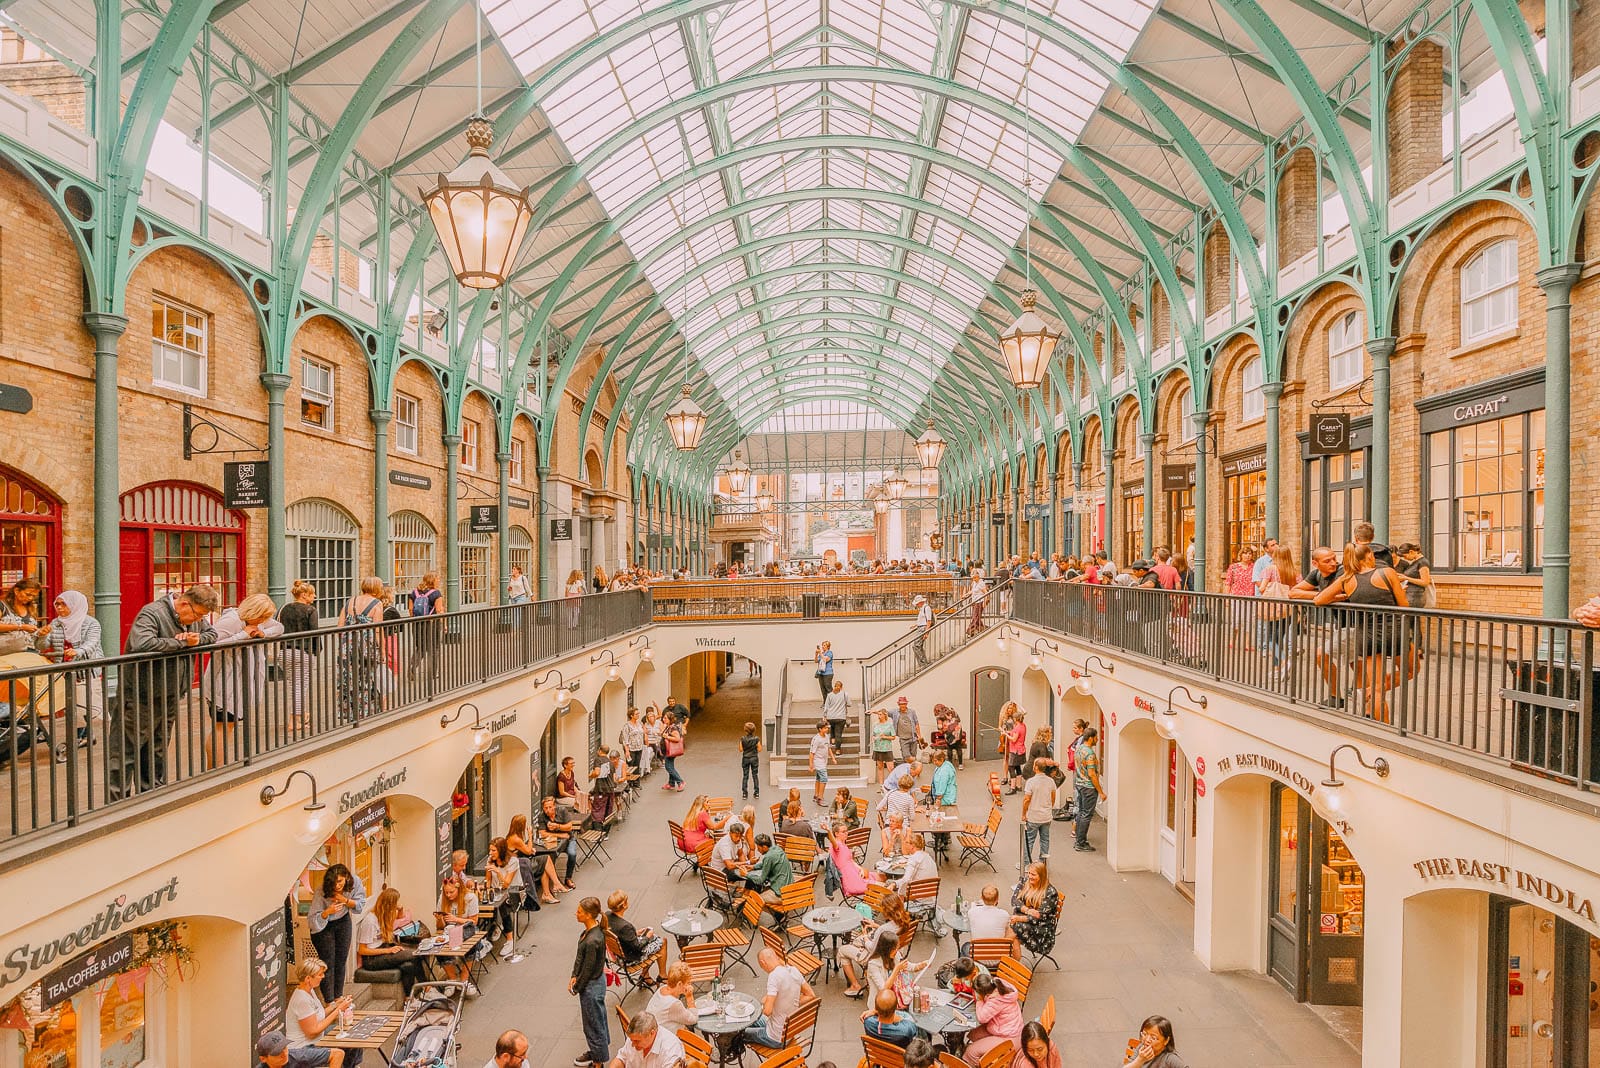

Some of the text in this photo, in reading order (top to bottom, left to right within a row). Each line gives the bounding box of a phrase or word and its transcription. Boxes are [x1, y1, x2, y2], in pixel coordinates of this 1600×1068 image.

[1453, 398, 1502, 421] CARAT
[1236, 456, 1263, 472] Venchi
[695, 637, 736, 647] Whittard
[491, 709, 517, 733] Italiani
[1235, 753, 1260, 767] EAST
[1260, 755, 1292, 780] INDIA
[339, 766, 407, 814] Sweetheart
[1413, 857, 1597, 924] THE EAST INDIA
[0, 876, 179, 989] Sweetheart
[108, 945, 131, 965] LOVE
